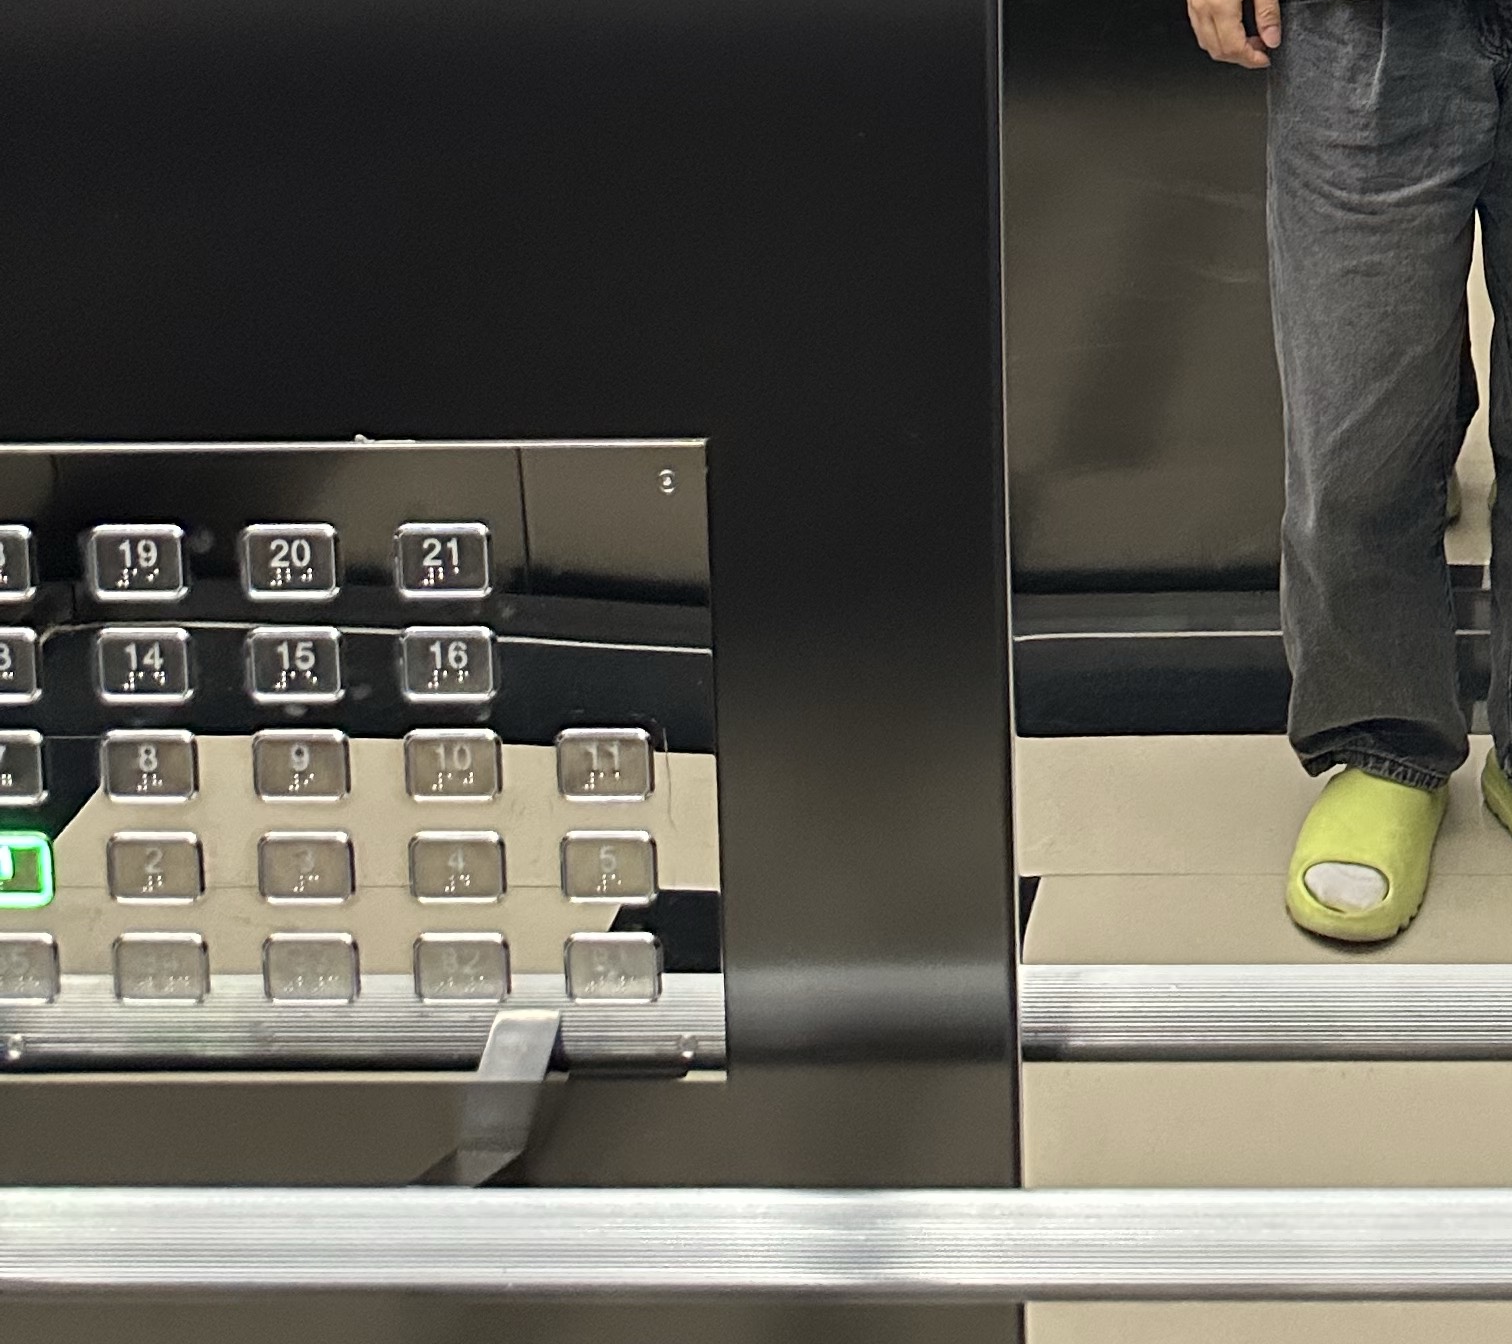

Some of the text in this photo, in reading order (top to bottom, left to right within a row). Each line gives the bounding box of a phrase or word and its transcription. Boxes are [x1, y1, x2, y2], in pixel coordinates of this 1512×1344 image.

[118, 539, 158, 568] 19
[270, 538, 311, 568] 20
[422, 538, 459, 567] 21
[124, 642, 163, 671] 14
[276, 641, 315, 670] 15
[430, 641, 468, 669] 16
[138, 744, 158, 772] 8
[290, 743, 310, 772] 9
[435, 743, 472, 770] 10
[585, 742, 619, 770] 11
[145, 847, 164, 874] 2
[296, 847, 313, 872] 3
[447, 845, 465, 872] 4
[600, 845, 617, 872] 5
